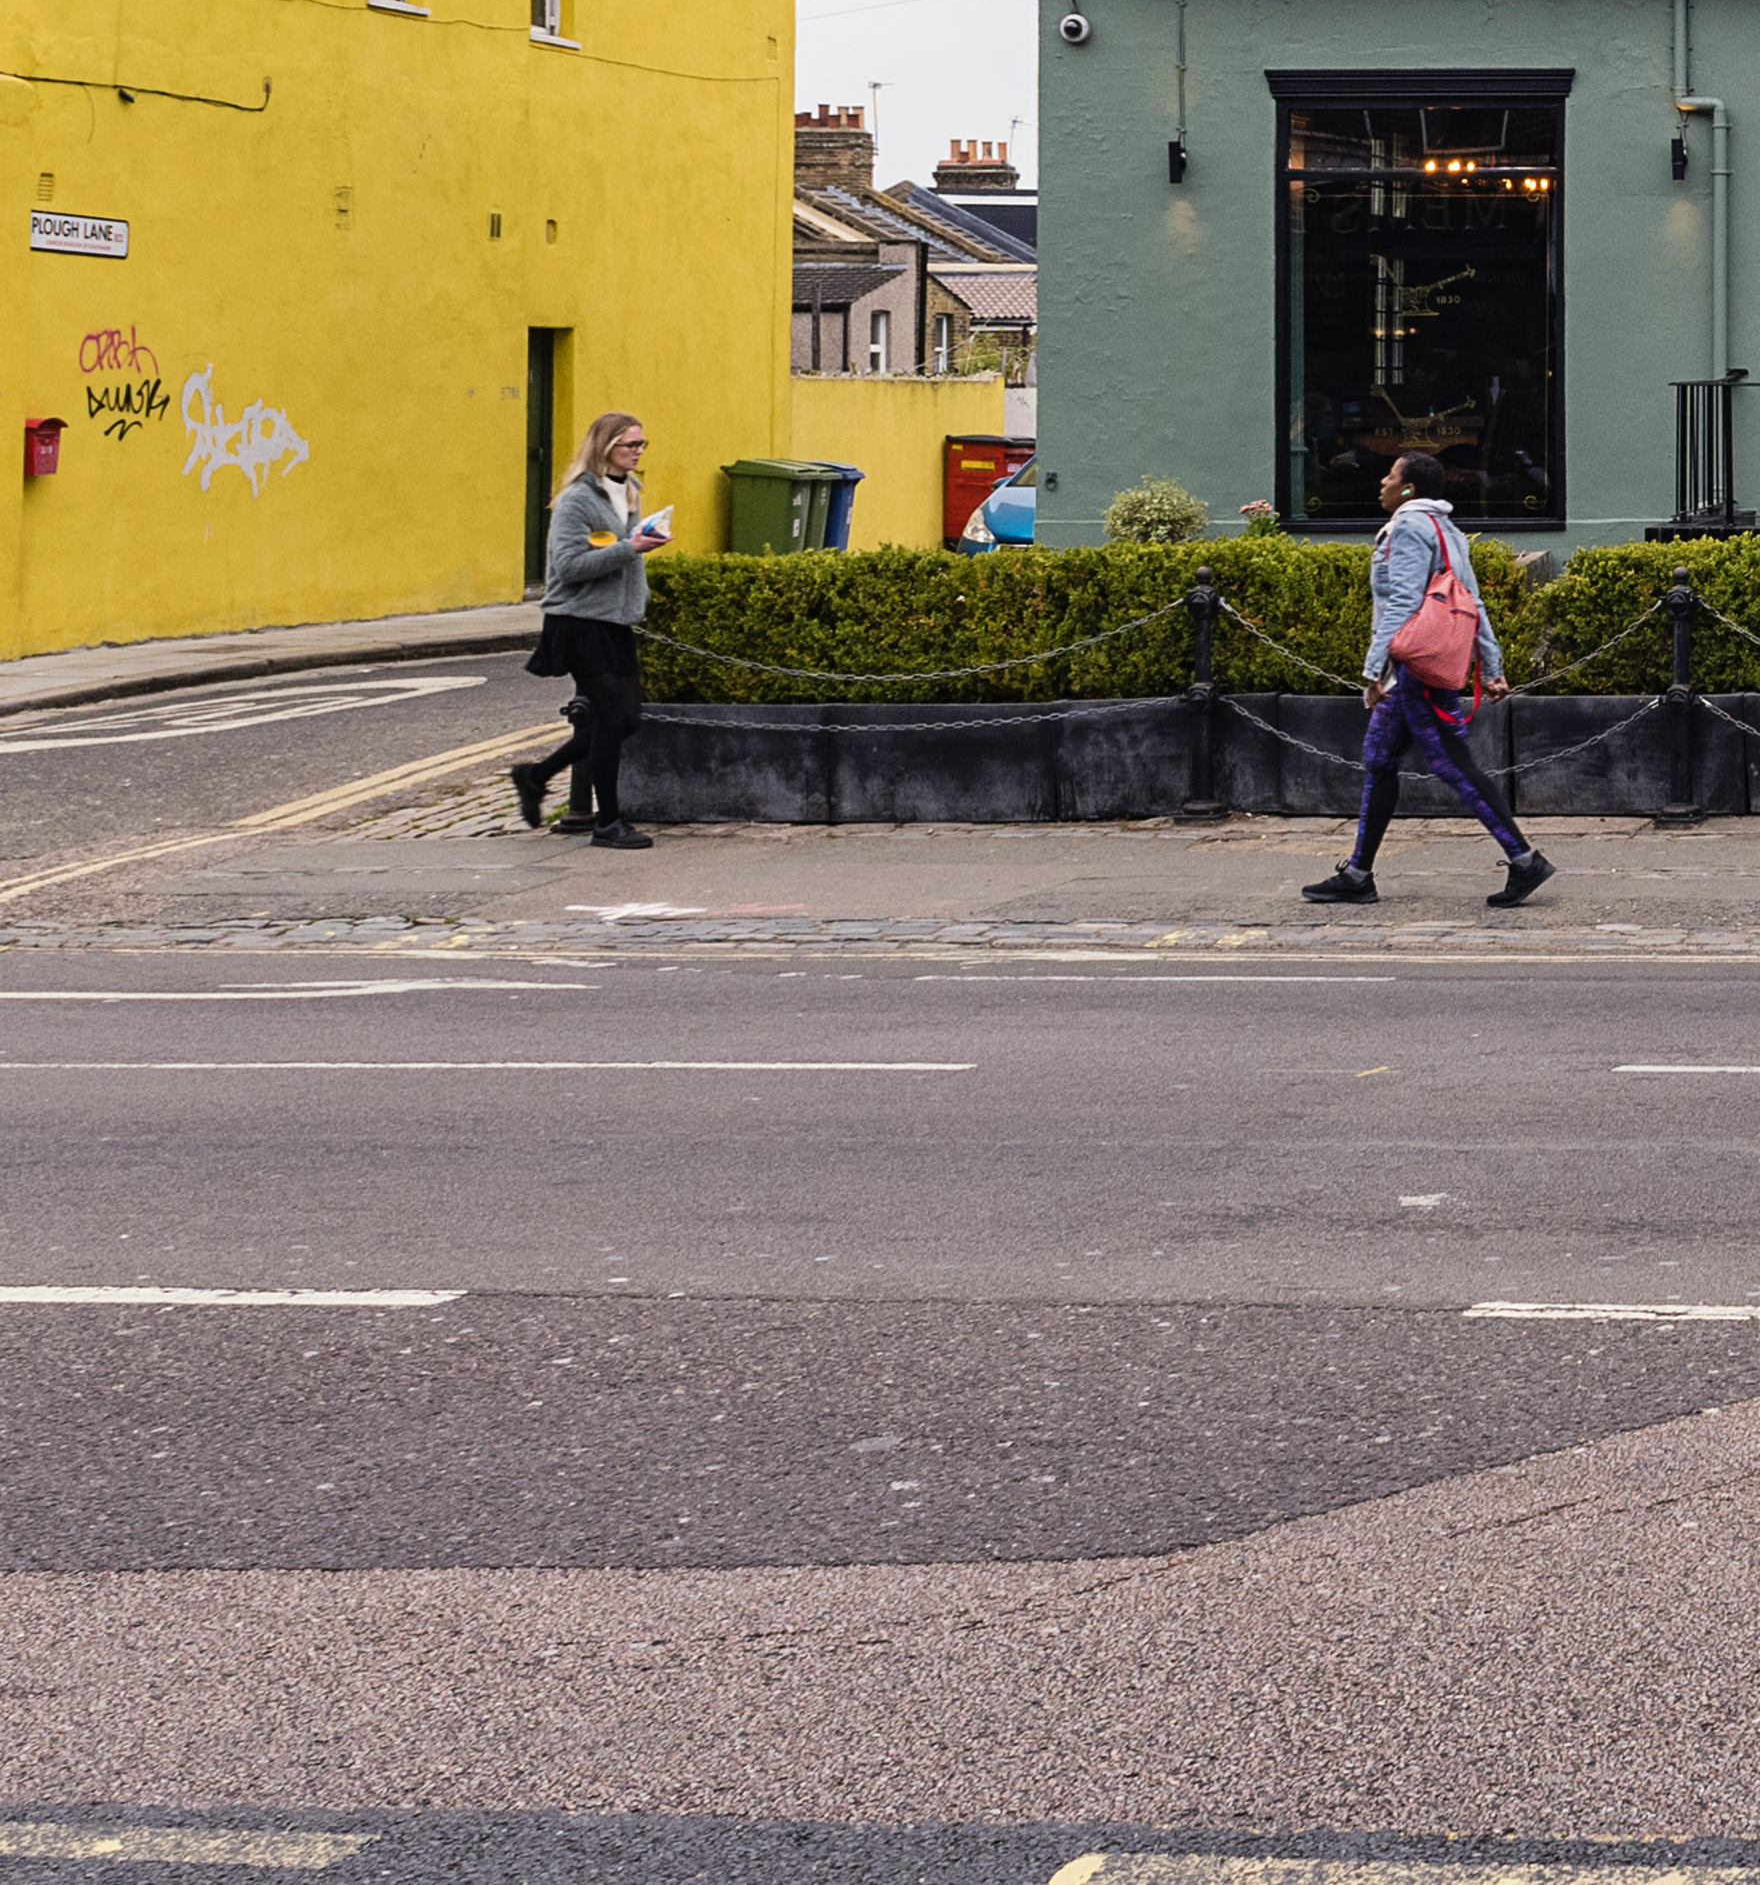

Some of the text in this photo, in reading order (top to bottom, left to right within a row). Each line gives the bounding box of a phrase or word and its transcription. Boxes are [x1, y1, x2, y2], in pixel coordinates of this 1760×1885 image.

[32, 217, 80, 238] PLOUGH
[84, 221, 113, 242] LANE
[1436, 295, 1461, 304] 1830
